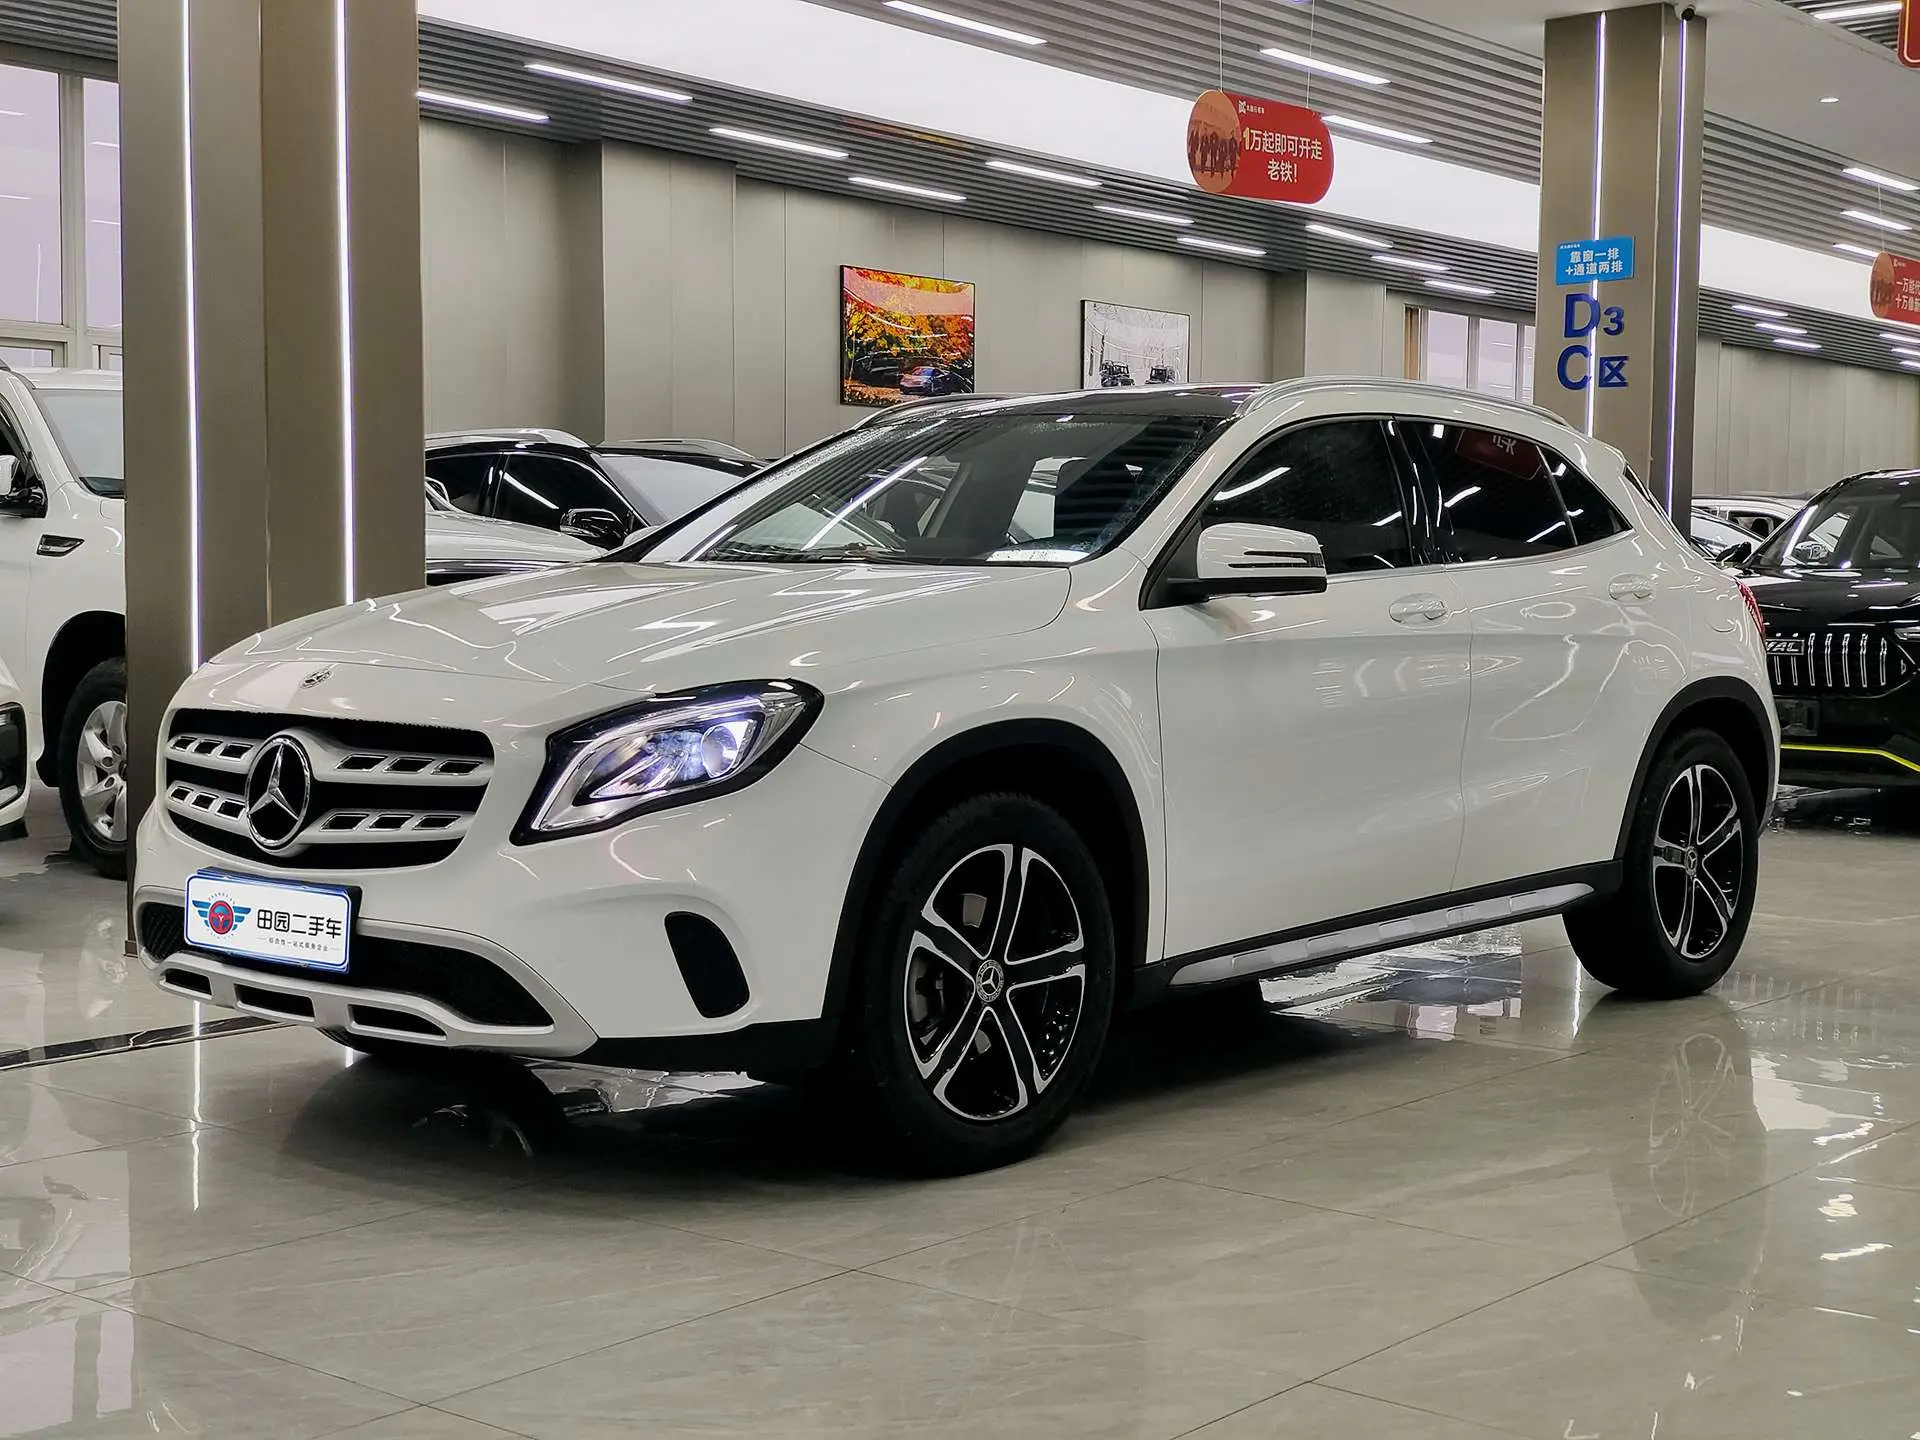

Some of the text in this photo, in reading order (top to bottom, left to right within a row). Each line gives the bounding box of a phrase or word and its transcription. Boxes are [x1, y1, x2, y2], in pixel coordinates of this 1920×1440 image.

[1243, 127, 1323, 161] 1万起即可开走
[1267, 158, 1298, 184] 老铁!
[1565, 260, 1624, 276] +通道两排
[1570, 247, 1620, 264] 靠窗一排
[257, 909, 343, 939] 田园二手车
